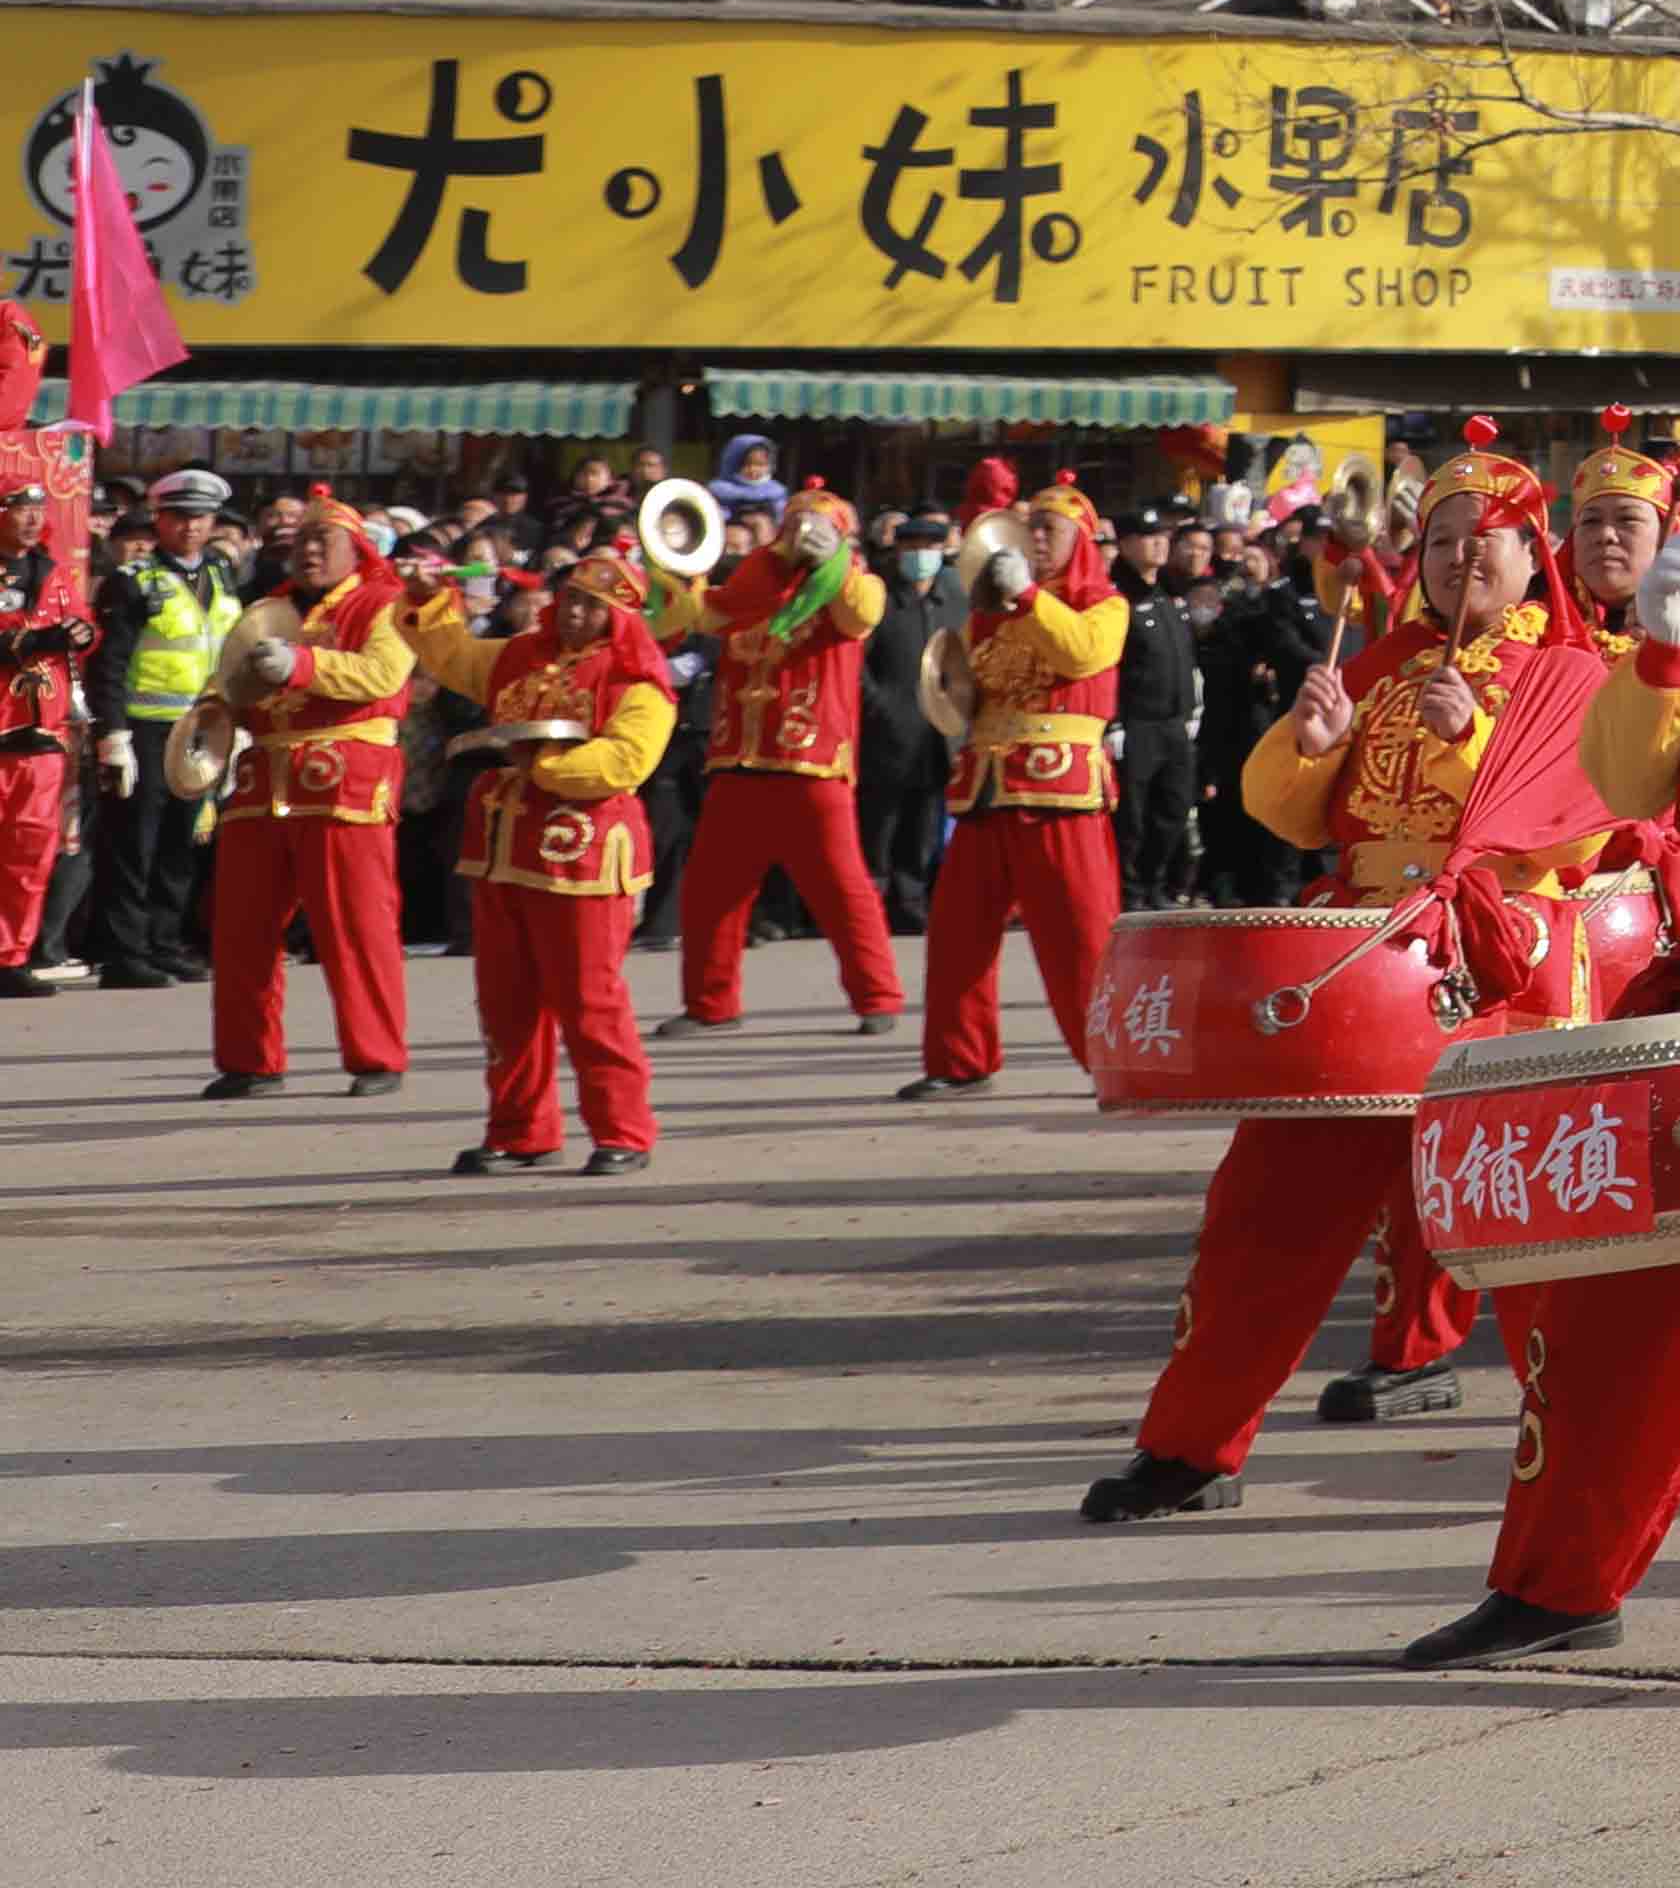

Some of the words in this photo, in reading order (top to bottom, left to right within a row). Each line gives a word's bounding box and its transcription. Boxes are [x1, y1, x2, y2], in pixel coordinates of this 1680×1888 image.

[347, 57, 1082, 304] 尤小妹
[1132, 85, 1480, 249] 水果店
[10, 240, 250, 299] 尤妹
[1133, 265, 1304, 307] FRUIT
[1345, 266, 1473, 308] SHOP
